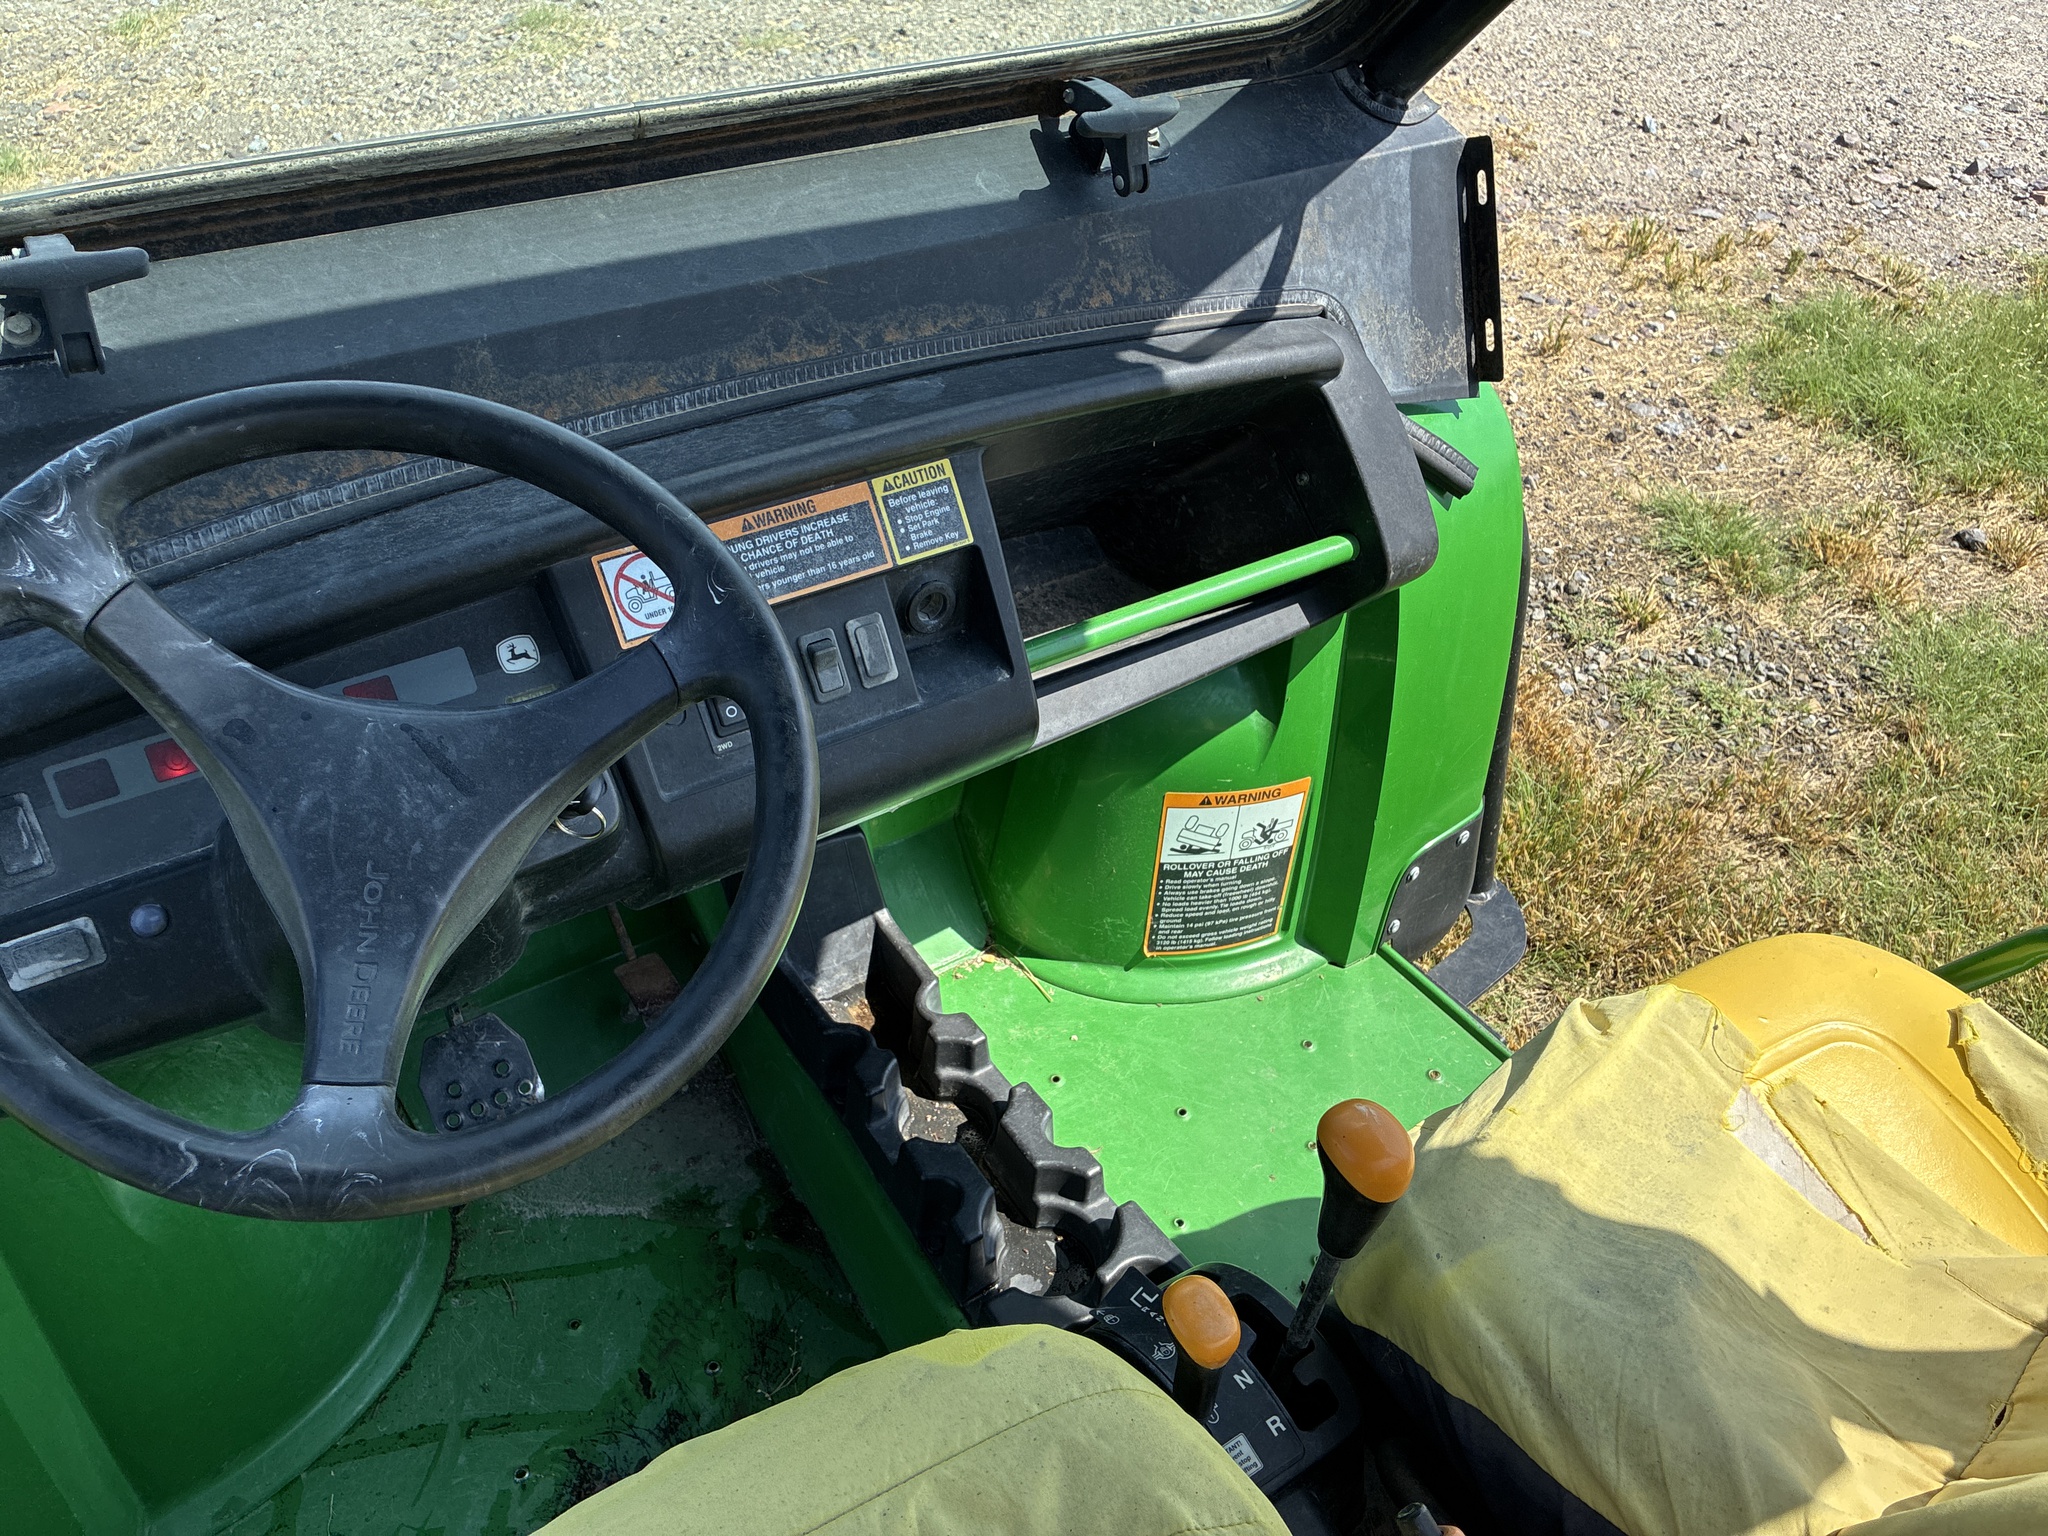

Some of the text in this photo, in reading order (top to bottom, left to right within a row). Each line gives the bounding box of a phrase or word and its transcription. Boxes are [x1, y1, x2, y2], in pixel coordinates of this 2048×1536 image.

[893, 463, 946, 489] CAUTION
[888, 485, 949, 508] Before leaving
[905, 499, 939, 513] vehicle:
[752, 500, 817, 528] WARNING
[905, 505, 951, 524] Stop Engine
[728, 512, 850, 554] UNG DRIVERS INCREASE
[907, 518, 940, 533] Set Park
[910, 530, 933, 541] Brake
[740, 529, 835, 563] CHANCE OF DEATH
[913, 536, 944, 550] Remove
[944, 531, 959, 541] Key
[748, 557, 779, 571] drivers
[780, 551, 798, 564] may
[800, 548, 814, 559] not
[815, 542, 825, 552] be
[827, 537, 844, 549] able
[844, 535, 854, 543] to
[755, 564, 786, 579] vehicle
[771, 573, 806, 590] younger
[807, 564, 826, 577] than
[827, 561, 837, 572] 16
[838, 556, 861, 570] years
[862, 550, 875, 561] old
[645, 608, 667, 620] UNDER
[716, 741, 733, 752] 2WD
[1215, 788, 1281, 805] WARNING
[1163, 847, 1290, 871] ROLLOVER OR FALLING OFF
[1183, 861, 1269, 878] MAY CAUSE DEATH
[340, 860, 390, 1055] JOHN DEERE
[1233, 1369, 1254, 1390] N
[1265, 1415, 1287, 1437] R
